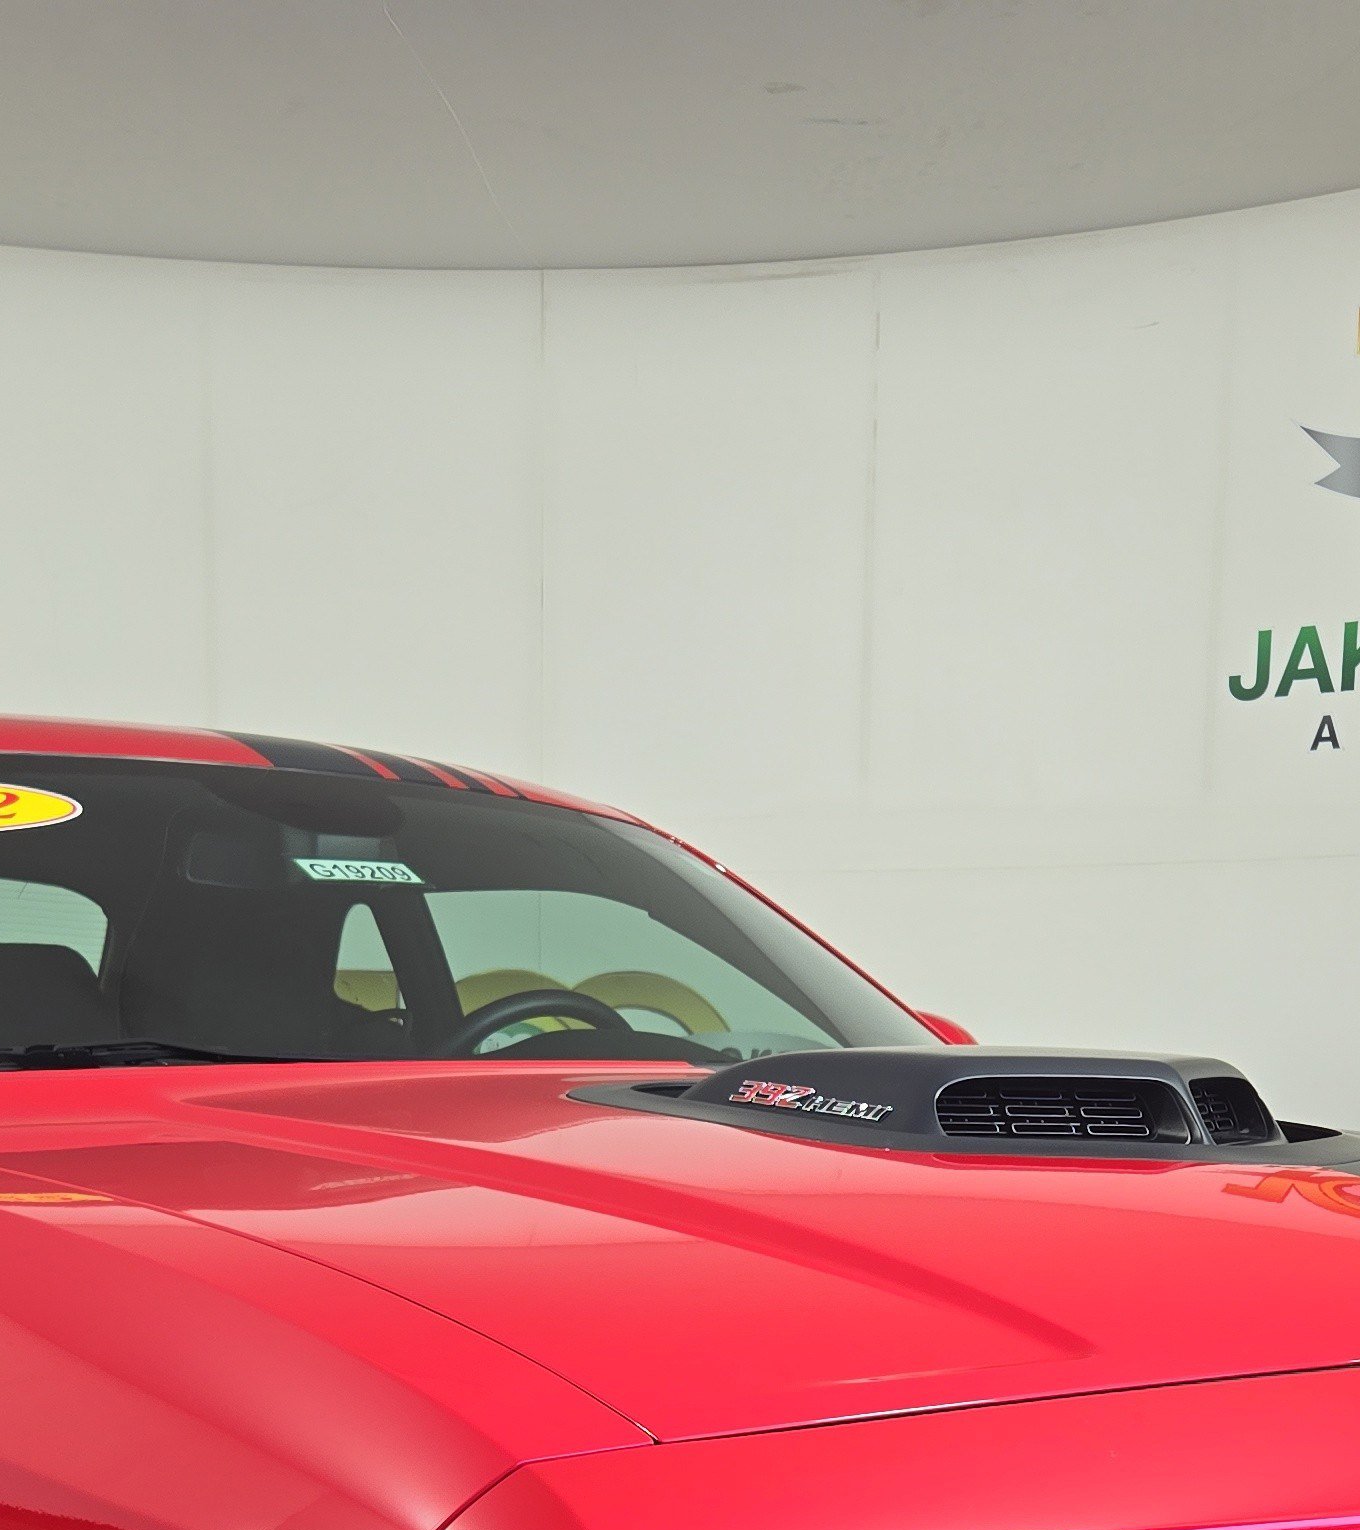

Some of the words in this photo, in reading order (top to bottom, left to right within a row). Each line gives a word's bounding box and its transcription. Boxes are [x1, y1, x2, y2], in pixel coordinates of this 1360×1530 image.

[309, 863, 412, 882] G19209
[729, 1079, 816, 1109] 392
[802, 1095, 893, 1121] HEMI
